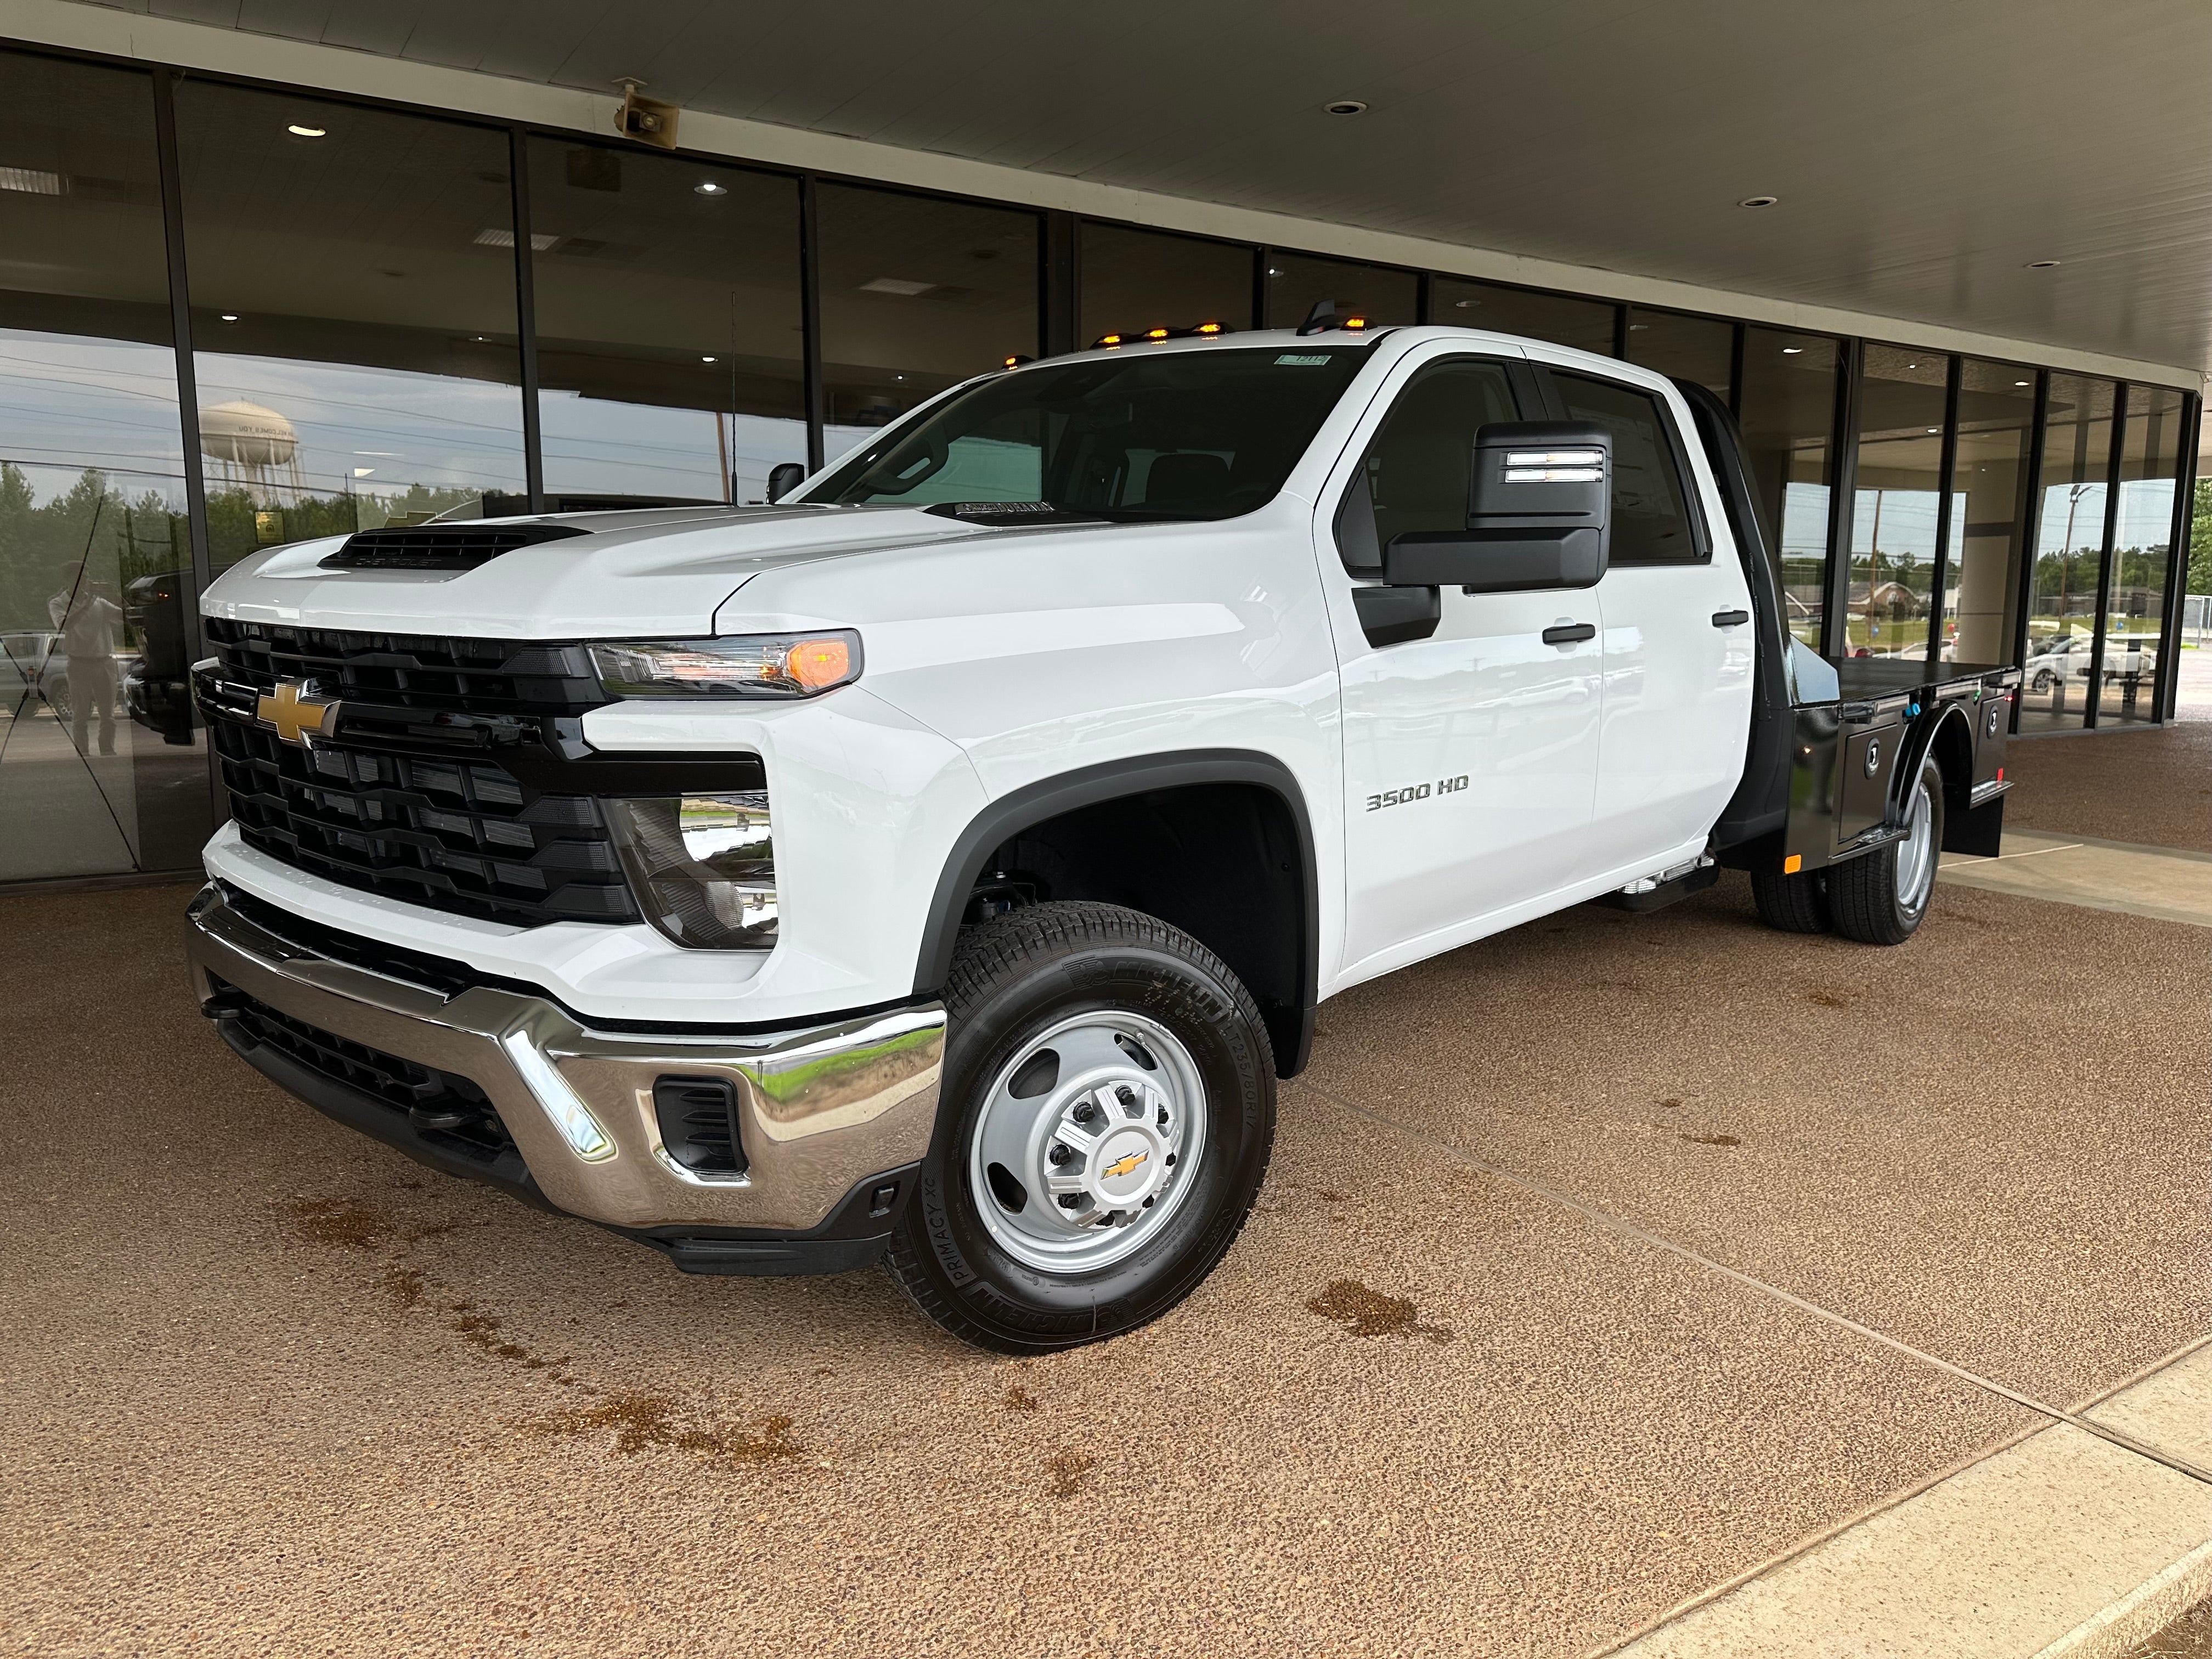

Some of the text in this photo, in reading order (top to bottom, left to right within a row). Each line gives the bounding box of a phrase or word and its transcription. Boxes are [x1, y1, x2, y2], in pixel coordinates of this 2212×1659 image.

[356, 557, 442, 567] CHEVROLET
[1366, 775, 1469, 812] 3500 HD
[1113, 961, 1223, 1018] MICHELIN
[923, 1177, 936, 1198] XC
[926, 1203, 968, 1280] PRIMACY
[966, 1287, 1092, 1333] MICHELIN
